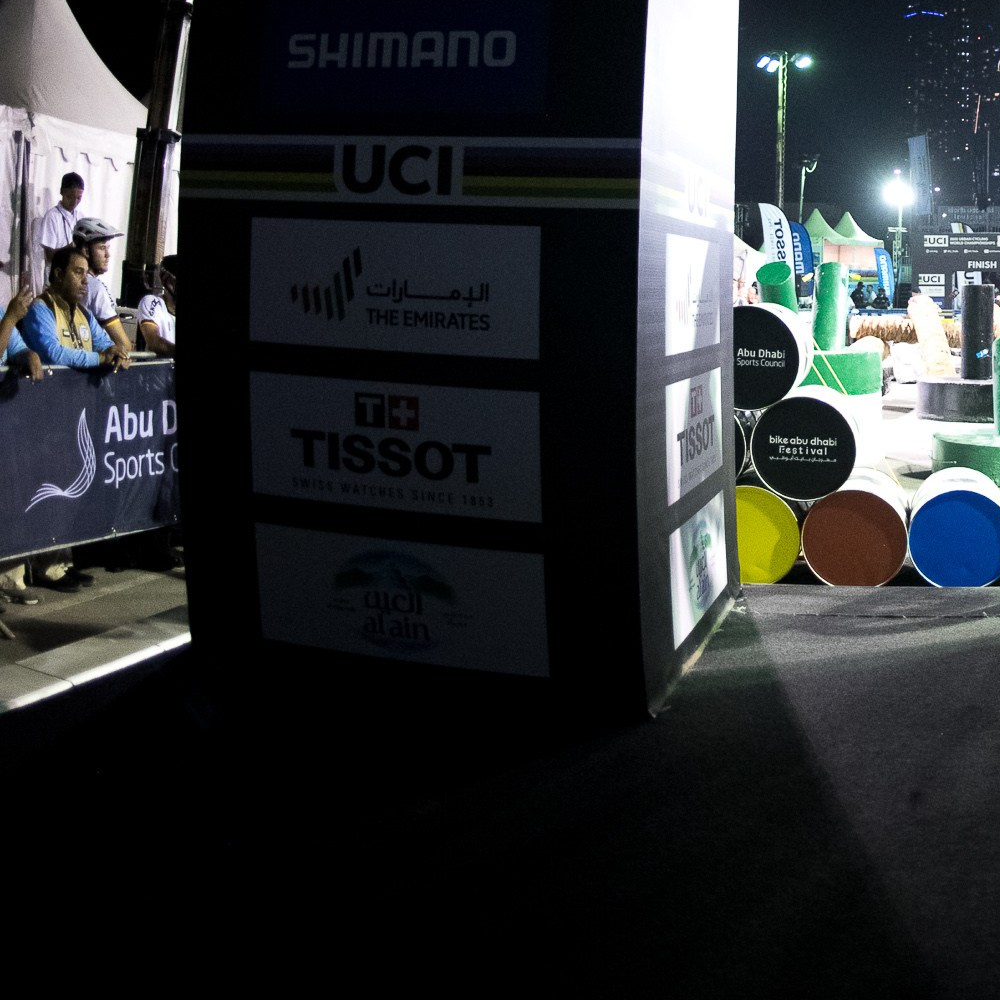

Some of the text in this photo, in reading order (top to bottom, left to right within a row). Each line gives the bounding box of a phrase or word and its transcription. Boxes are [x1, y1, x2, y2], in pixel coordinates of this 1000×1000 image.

[287, 30, 518, 69] SHIMANO
[341, 145, 453, 196] UCI
[928, 237, 946, 245] UCI
[968, 261, 997, 269] FINISH
[923, 275, 941, 283] UCI
[366, 308, 490, 331] THE EMIRATES
[736, 358, 785, 367] Sports Council
[737, 348, 785, 359] Abu Dhabi
[104, 404, 153, 443] Abu
[677, 415, 714, 466] TISSOT
[769, 435, 837, 446] bike abu dhabi
[779, 445, 828, 455] Festival
[291, 428, 492, 484] TISSOT
[104, 449, 164, 488] Sports
[292, 476, 334, 492] SWISS
[340, 483, 405, 499] WATCHES
[412, 490, 454, 505] SINCE
